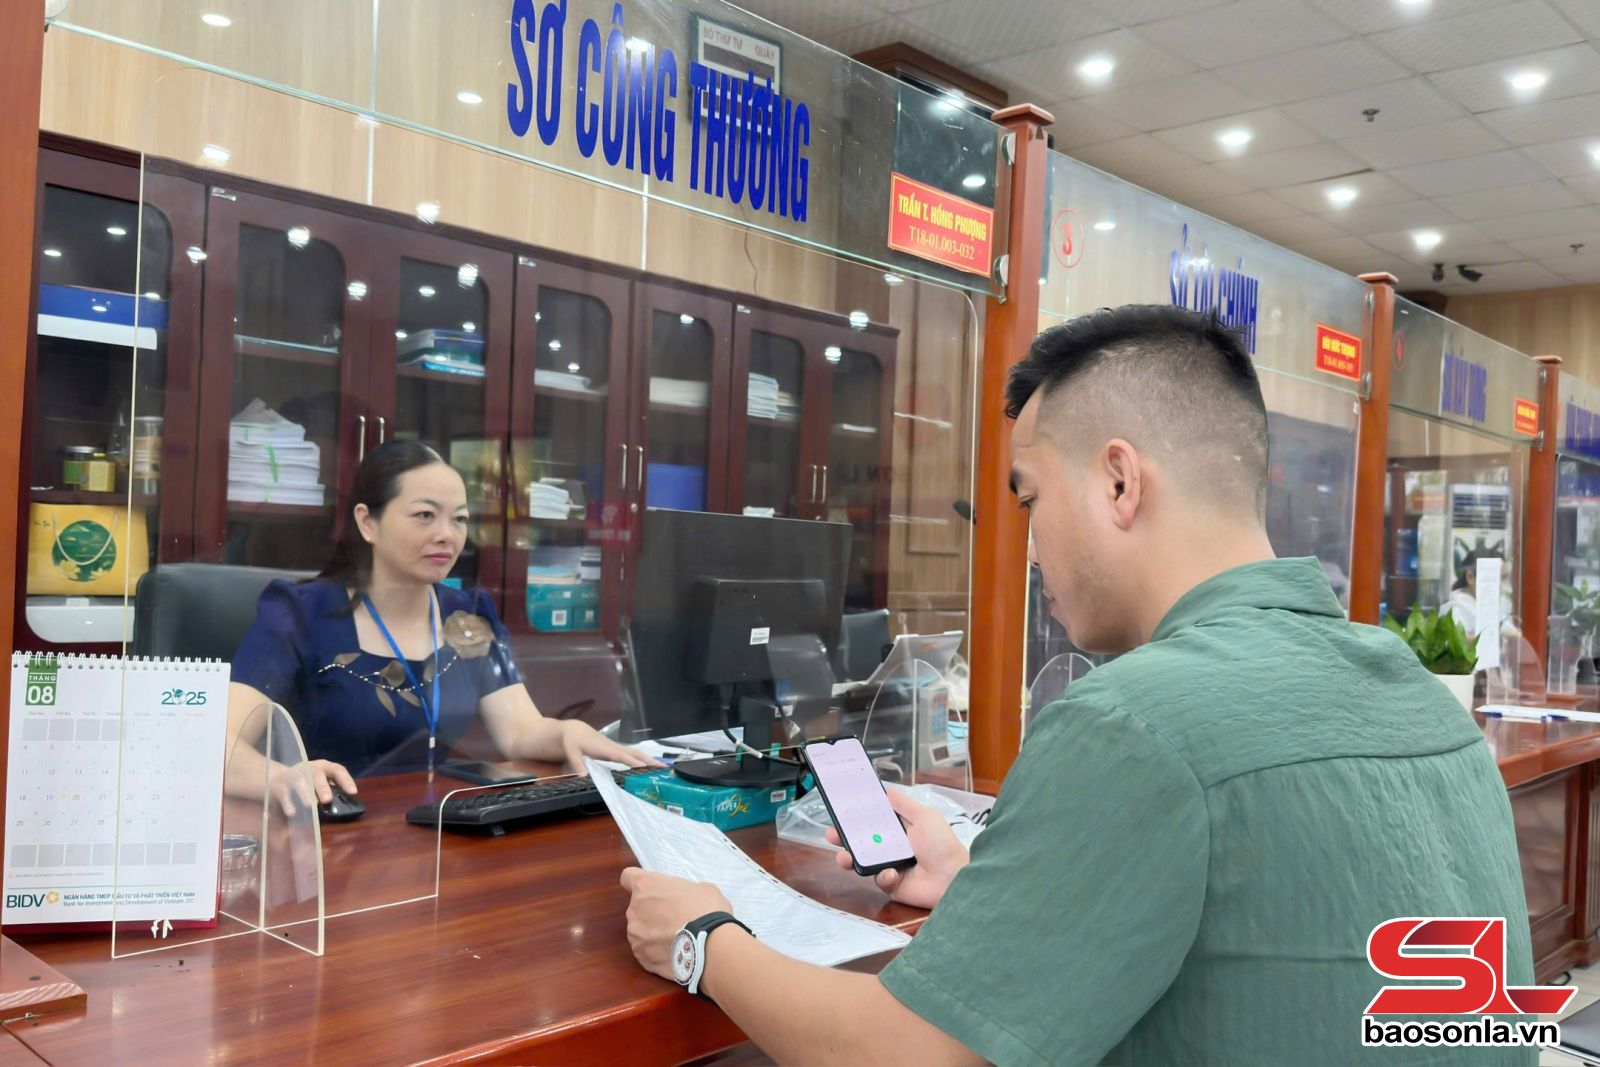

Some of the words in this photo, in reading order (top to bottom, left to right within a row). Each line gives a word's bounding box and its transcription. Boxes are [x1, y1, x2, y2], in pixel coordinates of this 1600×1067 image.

[575, 3, 677, 182] CÔNG
[689, 62, 810, 223] THƯƠNG
[27, 685, 54, 704] 08
[6, 893, 45, 908] BIDV
